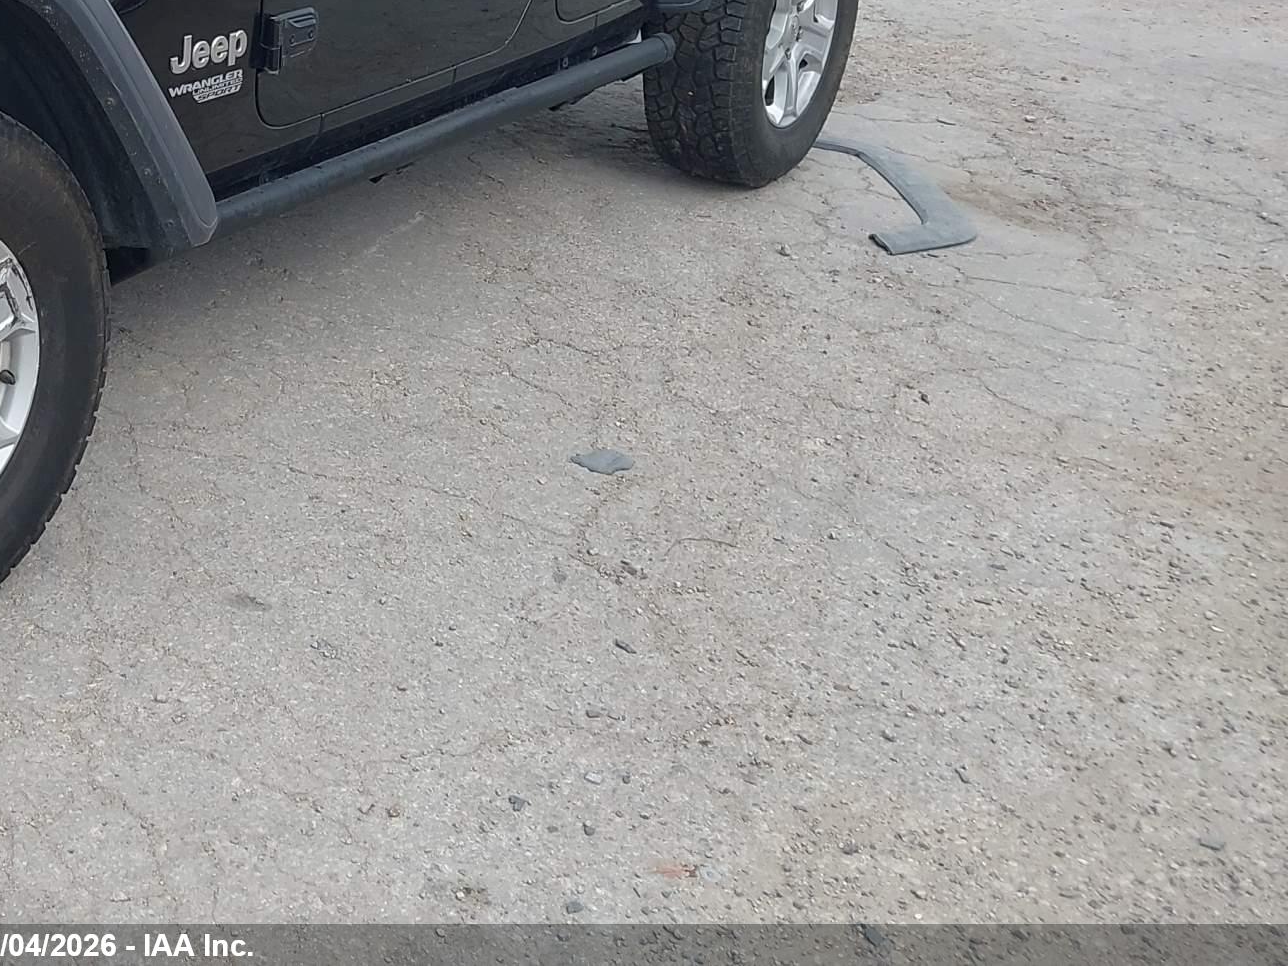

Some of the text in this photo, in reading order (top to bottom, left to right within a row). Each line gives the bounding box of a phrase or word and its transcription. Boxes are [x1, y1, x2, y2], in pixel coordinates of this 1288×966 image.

[170, 30, 248, 74] Jeep
[168, 69, 243, 98] WRANGLER
[193, 77, 243, 95] UNLIMITED
